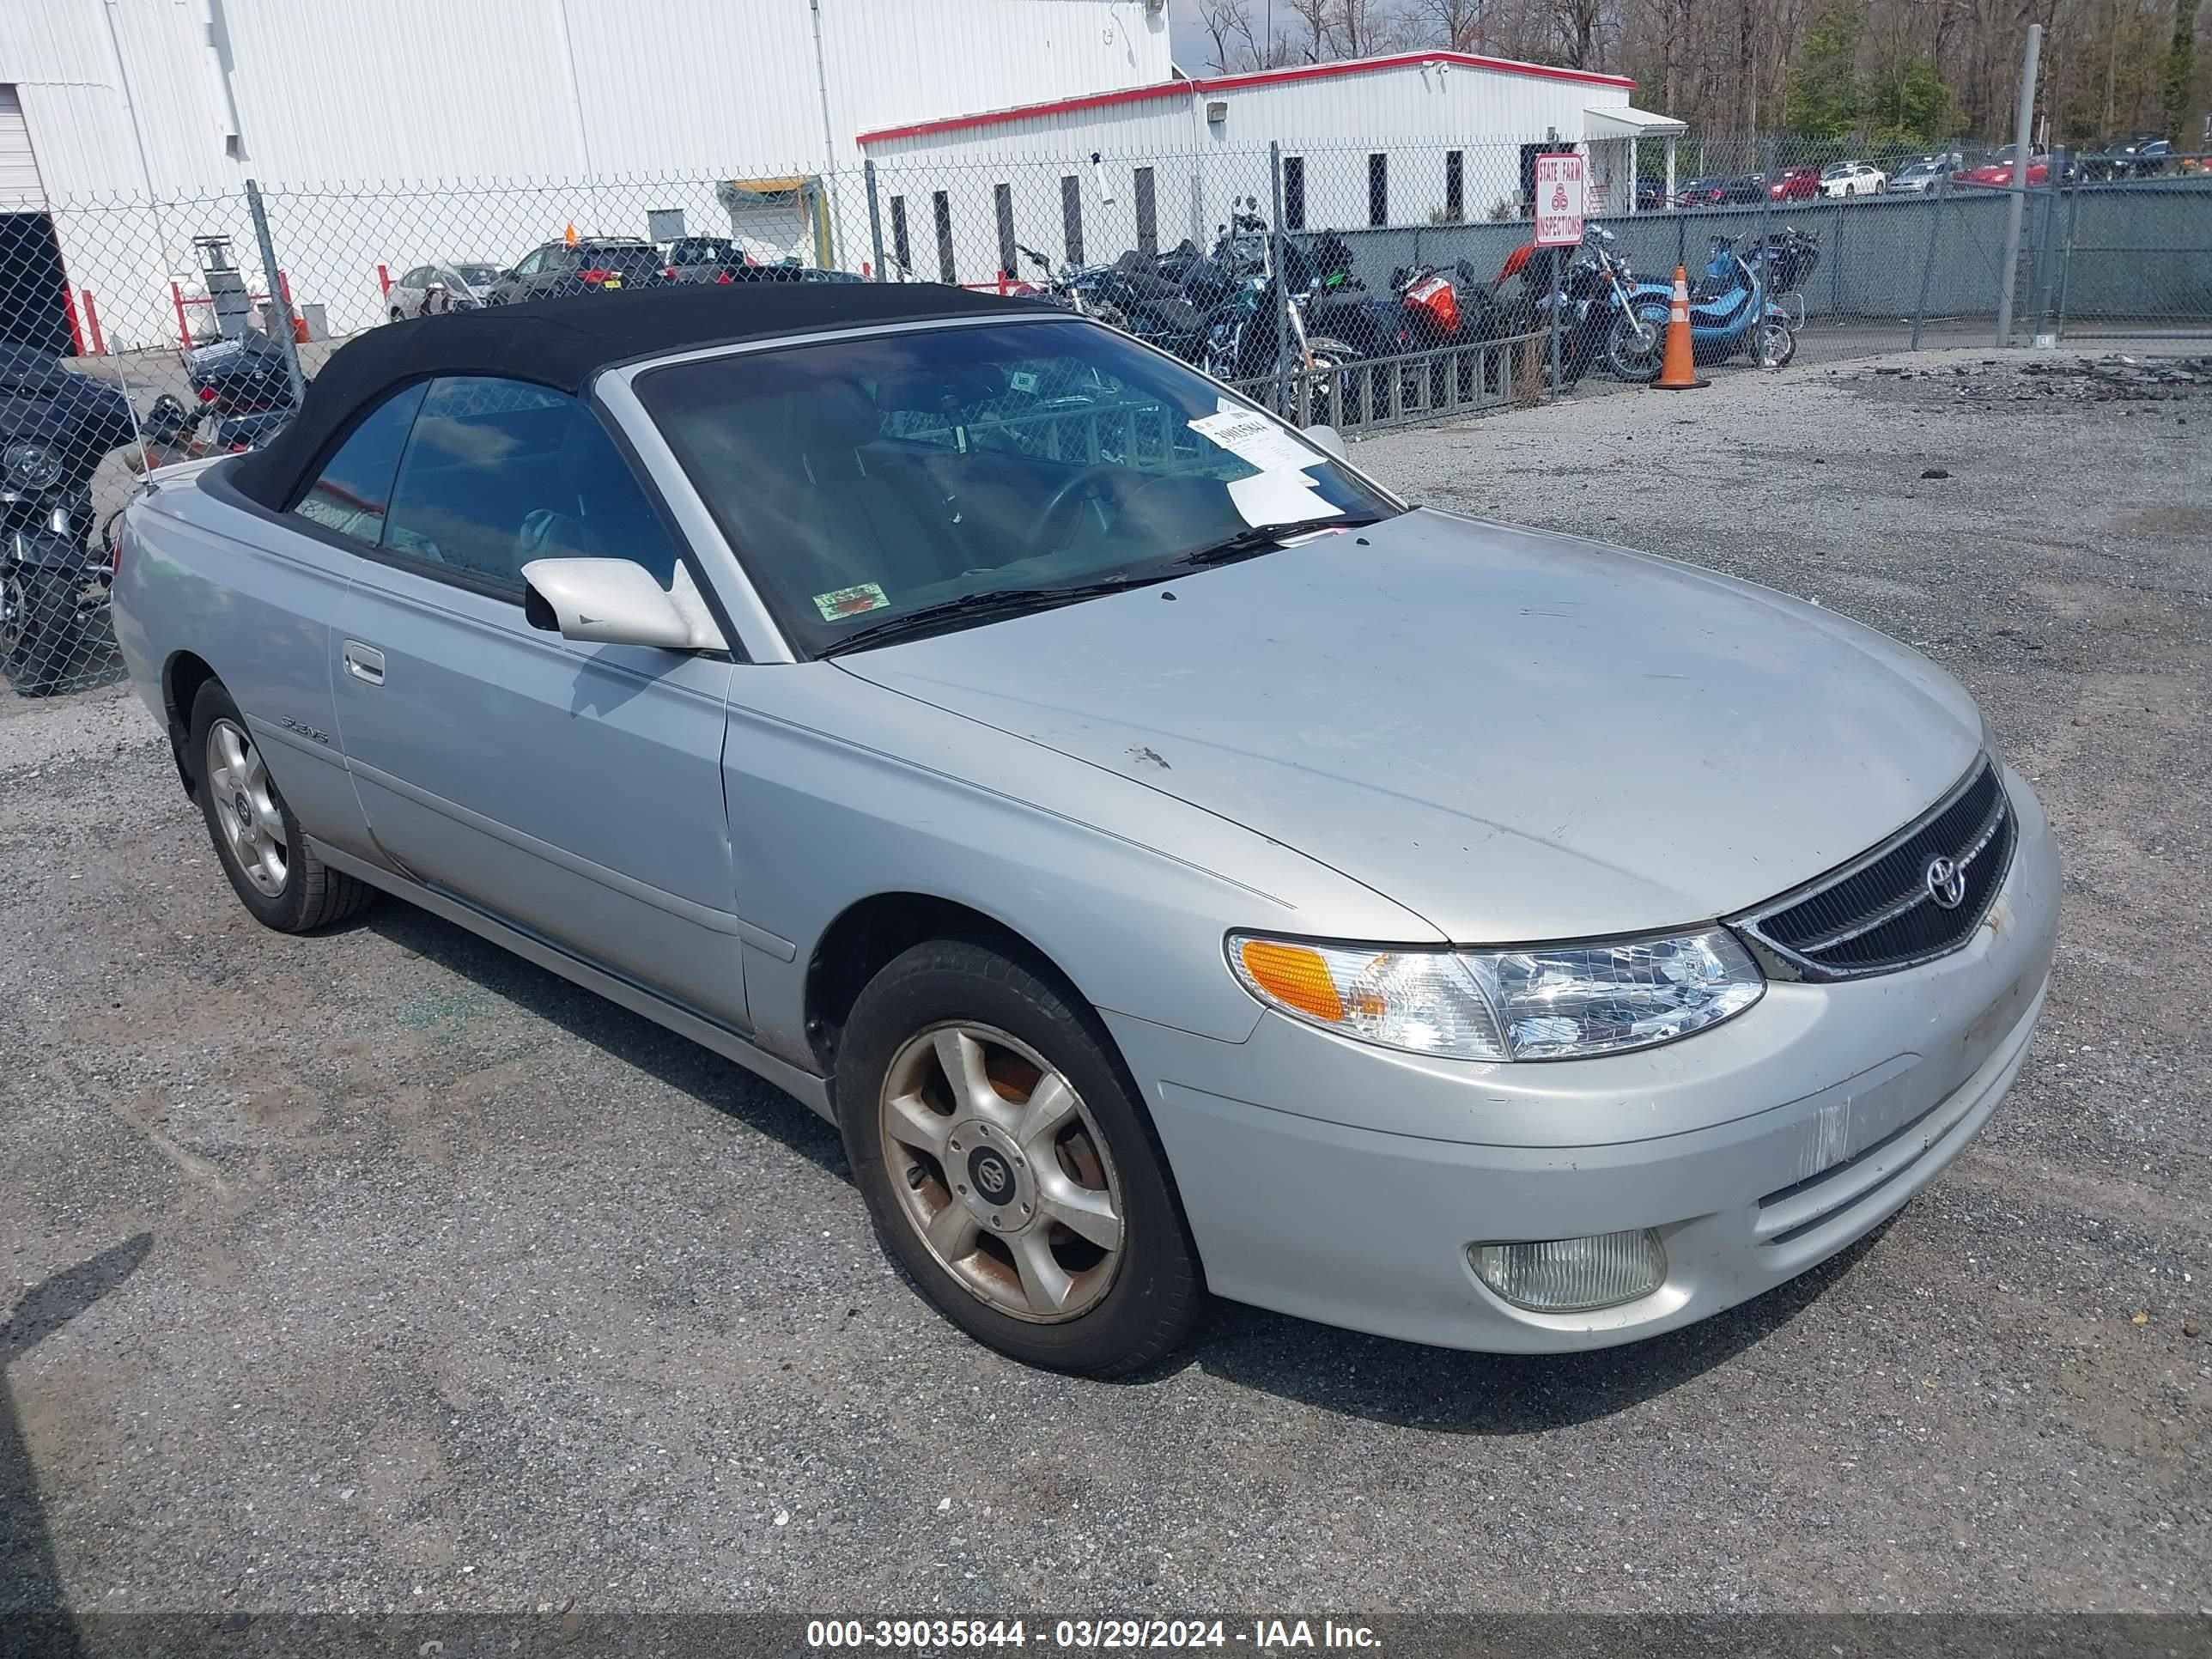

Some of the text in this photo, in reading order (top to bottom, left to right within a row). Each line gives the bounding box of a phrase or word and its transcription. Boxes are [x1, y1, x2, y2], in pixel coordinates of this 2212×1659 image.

[1540, 161, 1558, 182] STATE
[1563, 161, 1581, 182] FARM
[1538, 215, 1581, 237] INSPECTIONS
[1214, 420, 1270, 443] 39035844
